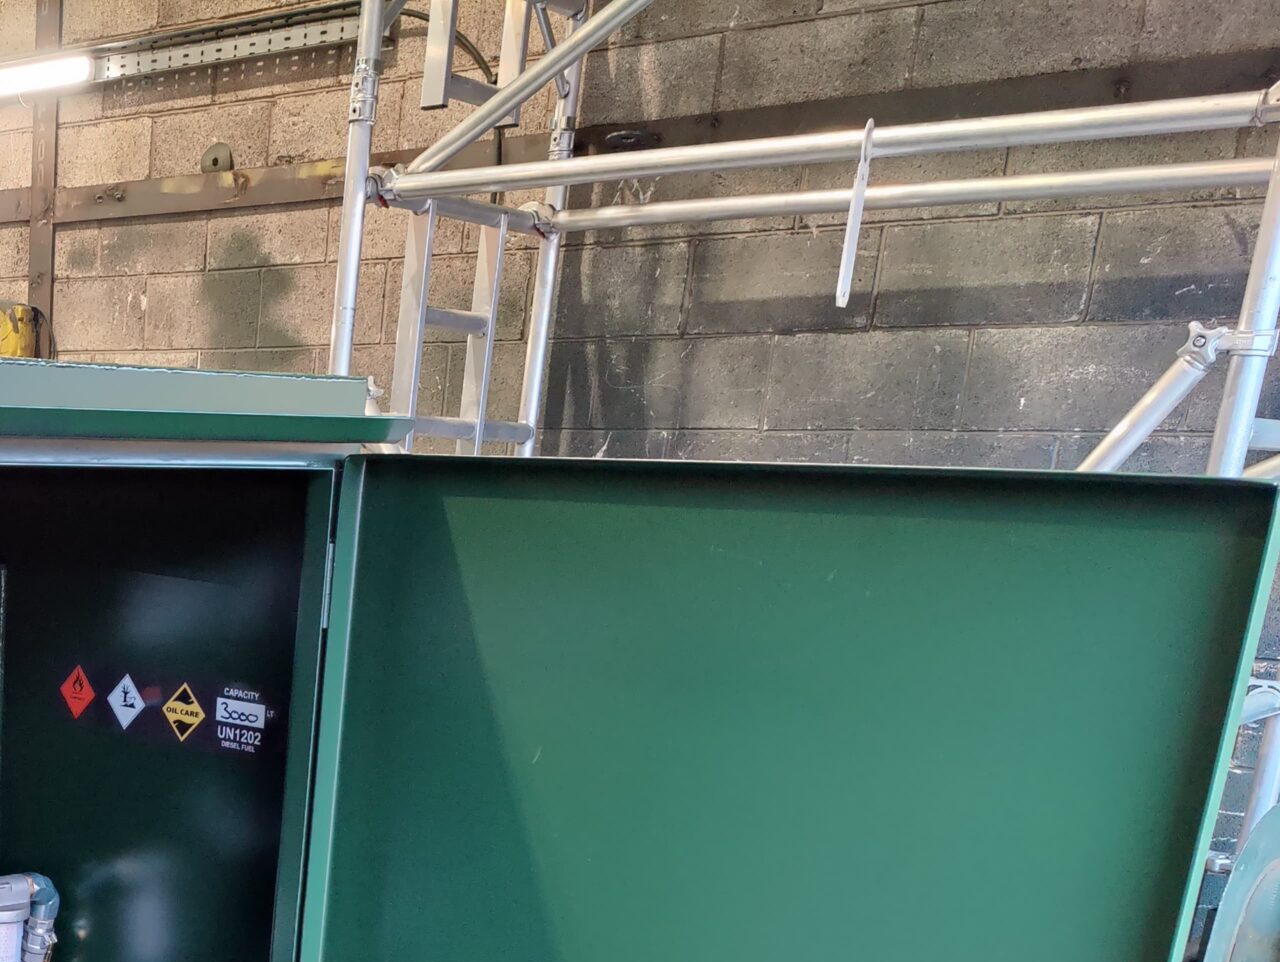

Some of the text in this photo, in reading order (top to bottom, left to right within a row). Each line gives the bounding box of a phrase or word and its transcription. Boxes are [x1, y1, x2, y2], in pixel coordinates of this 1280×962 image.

[224, 687, 260, 700] CAPACITY
[166, 706, 200, 718] OIL CARE
[220, 701, 259, 723] 3000
[217, 724, 262, 745] UN1202
[221, 740, 256, 753] DIESEL FUEL
